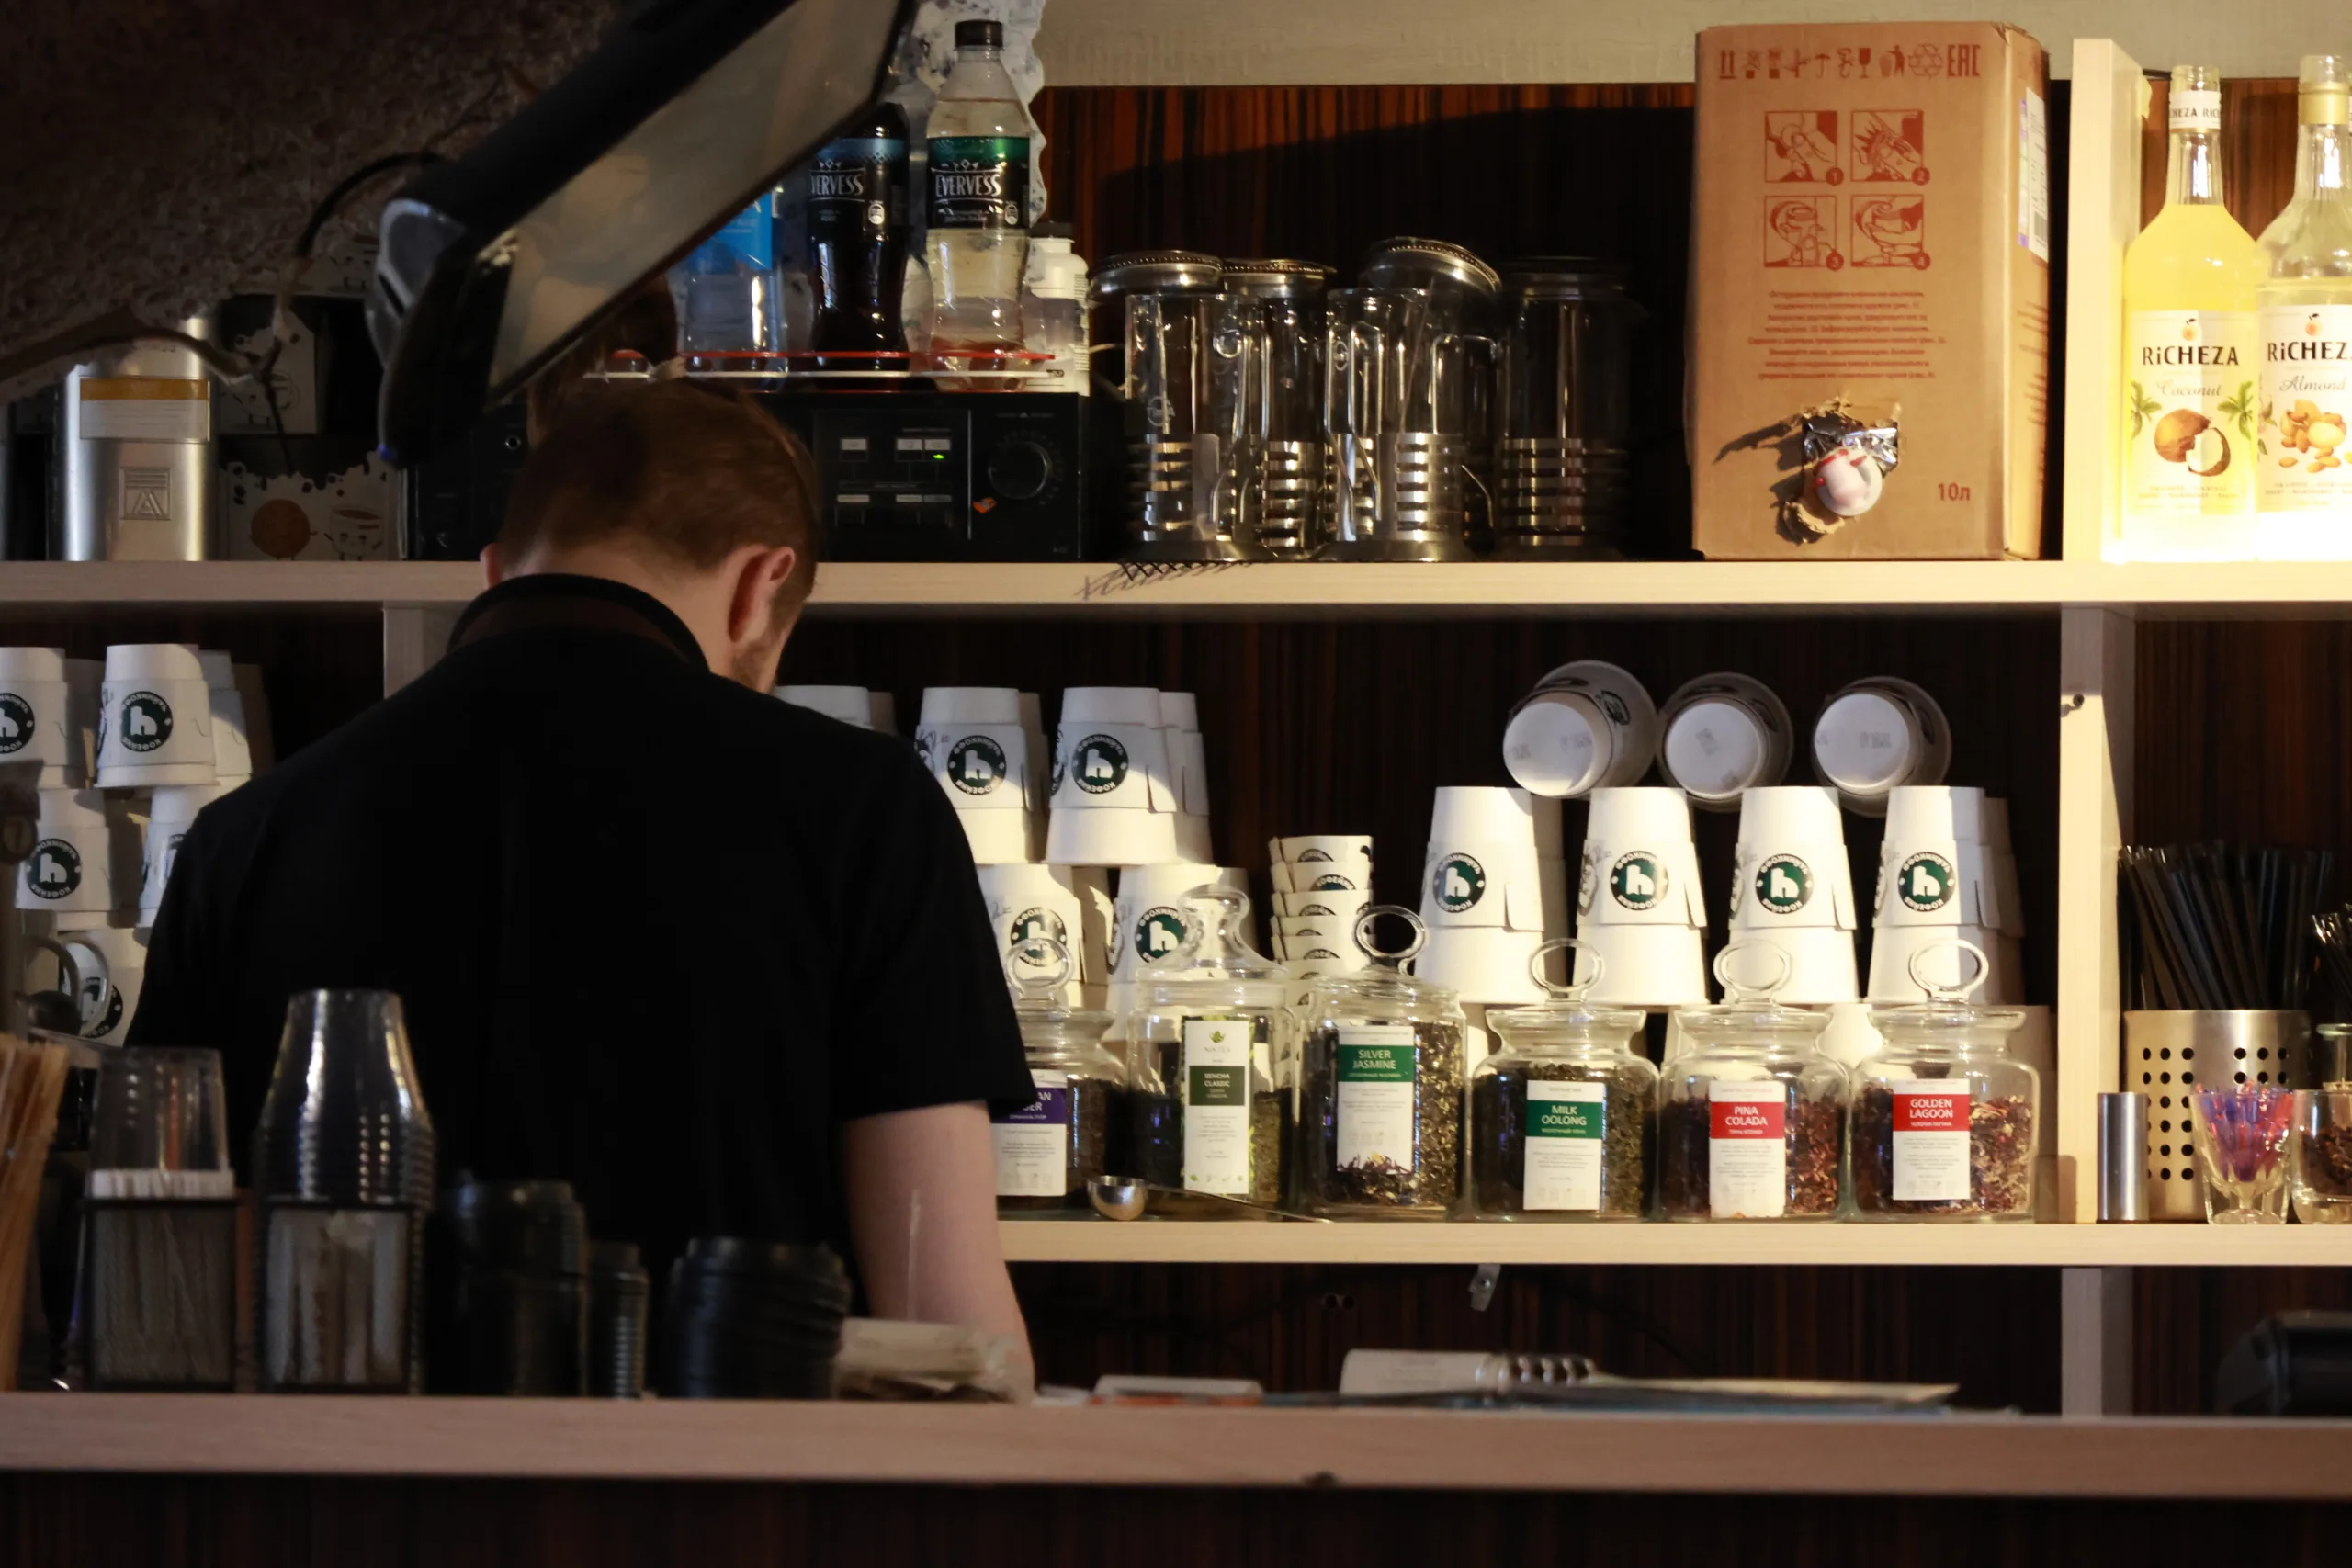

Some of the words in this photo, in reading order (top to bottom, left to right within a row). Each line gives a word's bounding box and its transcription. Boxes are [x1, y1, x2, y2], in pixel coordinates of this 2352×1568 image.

[934, 173, 1001, 197] EVERVESS
[2267, 341, 2352, 362] RiCHEZ
[2155, 378, 2222, 397] Coconut
[2278, 375, 2346, 393] Almond
[1358, 1049, 1391, 1059] SILVER
[1352, 1059, 1396, 1069] JASMINE
[1204, 1079, 1230, 1088] CLASSIC
[1037, 1091, 1052, 1101] AN
[1910, 1098, 1952, 1109] GOLDEN
[1551, 1105, 1578, 1115] MILK
[1734, 1105, 1759, 1116] PINA
[1909, 1109, 1953, 1119] LAGOON
[1541, 1114, 1588, 1126] OOLONG
[1724, 1116, 1768, 1126] COLADA
